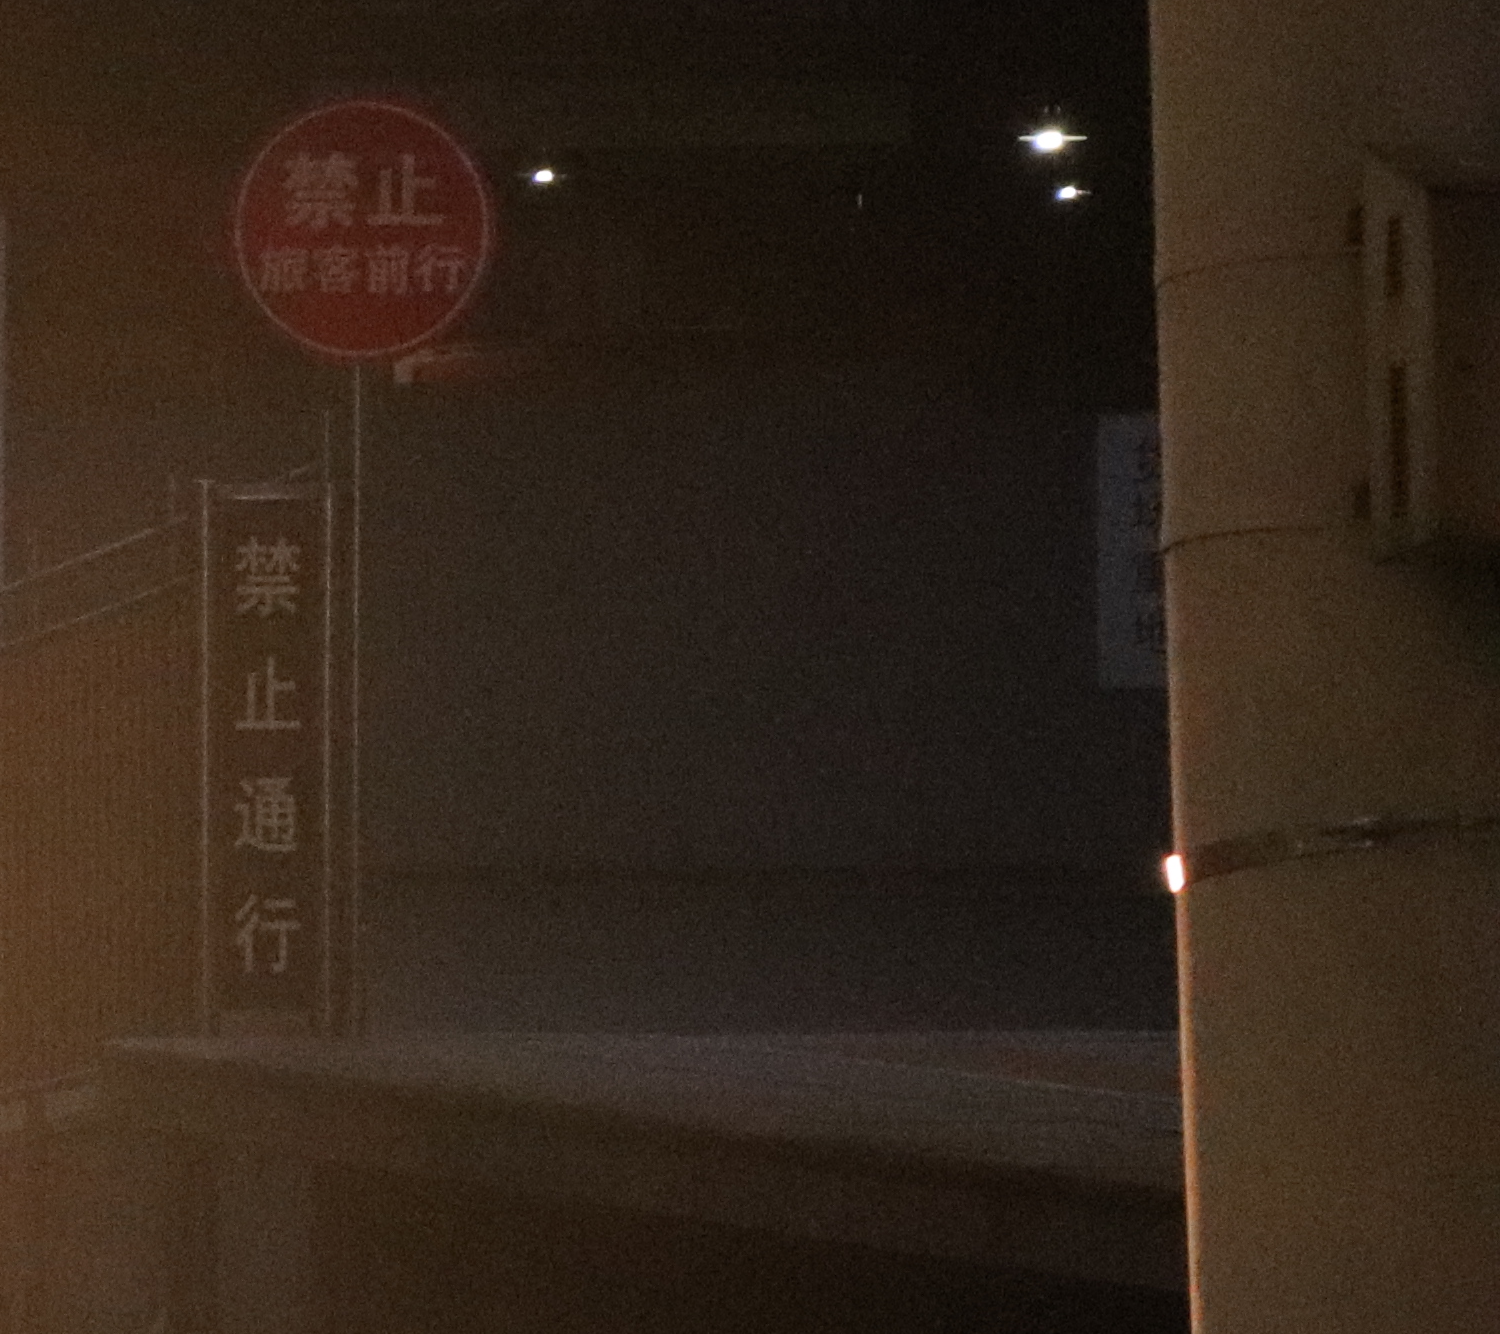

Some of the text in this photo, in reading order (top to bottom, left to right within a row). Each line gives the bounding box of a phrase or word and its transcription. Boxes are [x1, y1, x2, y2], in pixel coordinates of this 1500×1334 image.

[282, 151, 445, 228] 禁止
[260, 244, 467, 295] 旅客前行
[233, 535, 303, 976] 禁止通行
